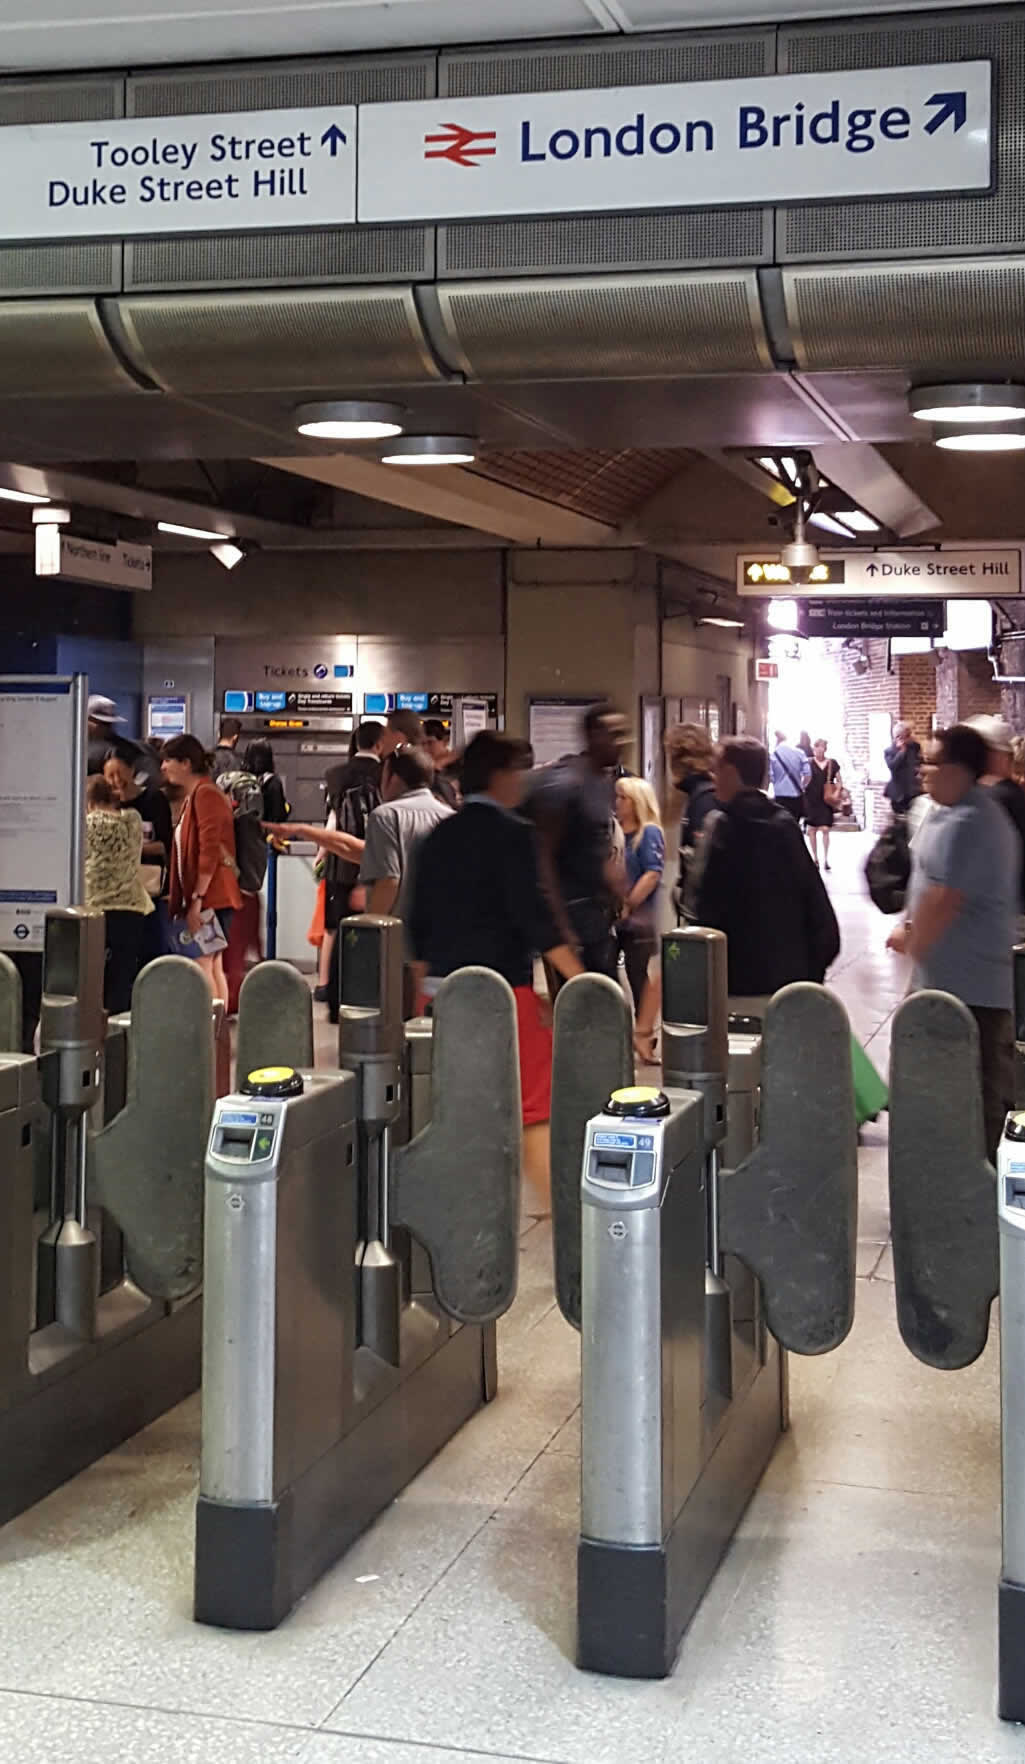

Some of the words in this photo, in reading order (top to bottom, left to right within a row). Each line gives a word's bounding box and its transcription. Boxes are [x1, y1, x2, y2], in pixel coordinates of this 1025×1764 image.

[520, 113, 715, 162] London
[738, 100, 911, 153] Bridge
[90, 138, 198, 169] Tooley
[210, 132, 312, 161] Street
[48, 179, 127, 207] Duke
[139, 173, 239, 202] Street
[253, 168, 308, 197] Hill
[882, 563, 921, 577] Duke
[927, 562, 976, 576] Street
[982, 561, 1011, 576] Hill
[263, 665, 309, 678] Tickets
[258, 694, 269, 702] Buy
[639, 1138, 651, 1147] 49
